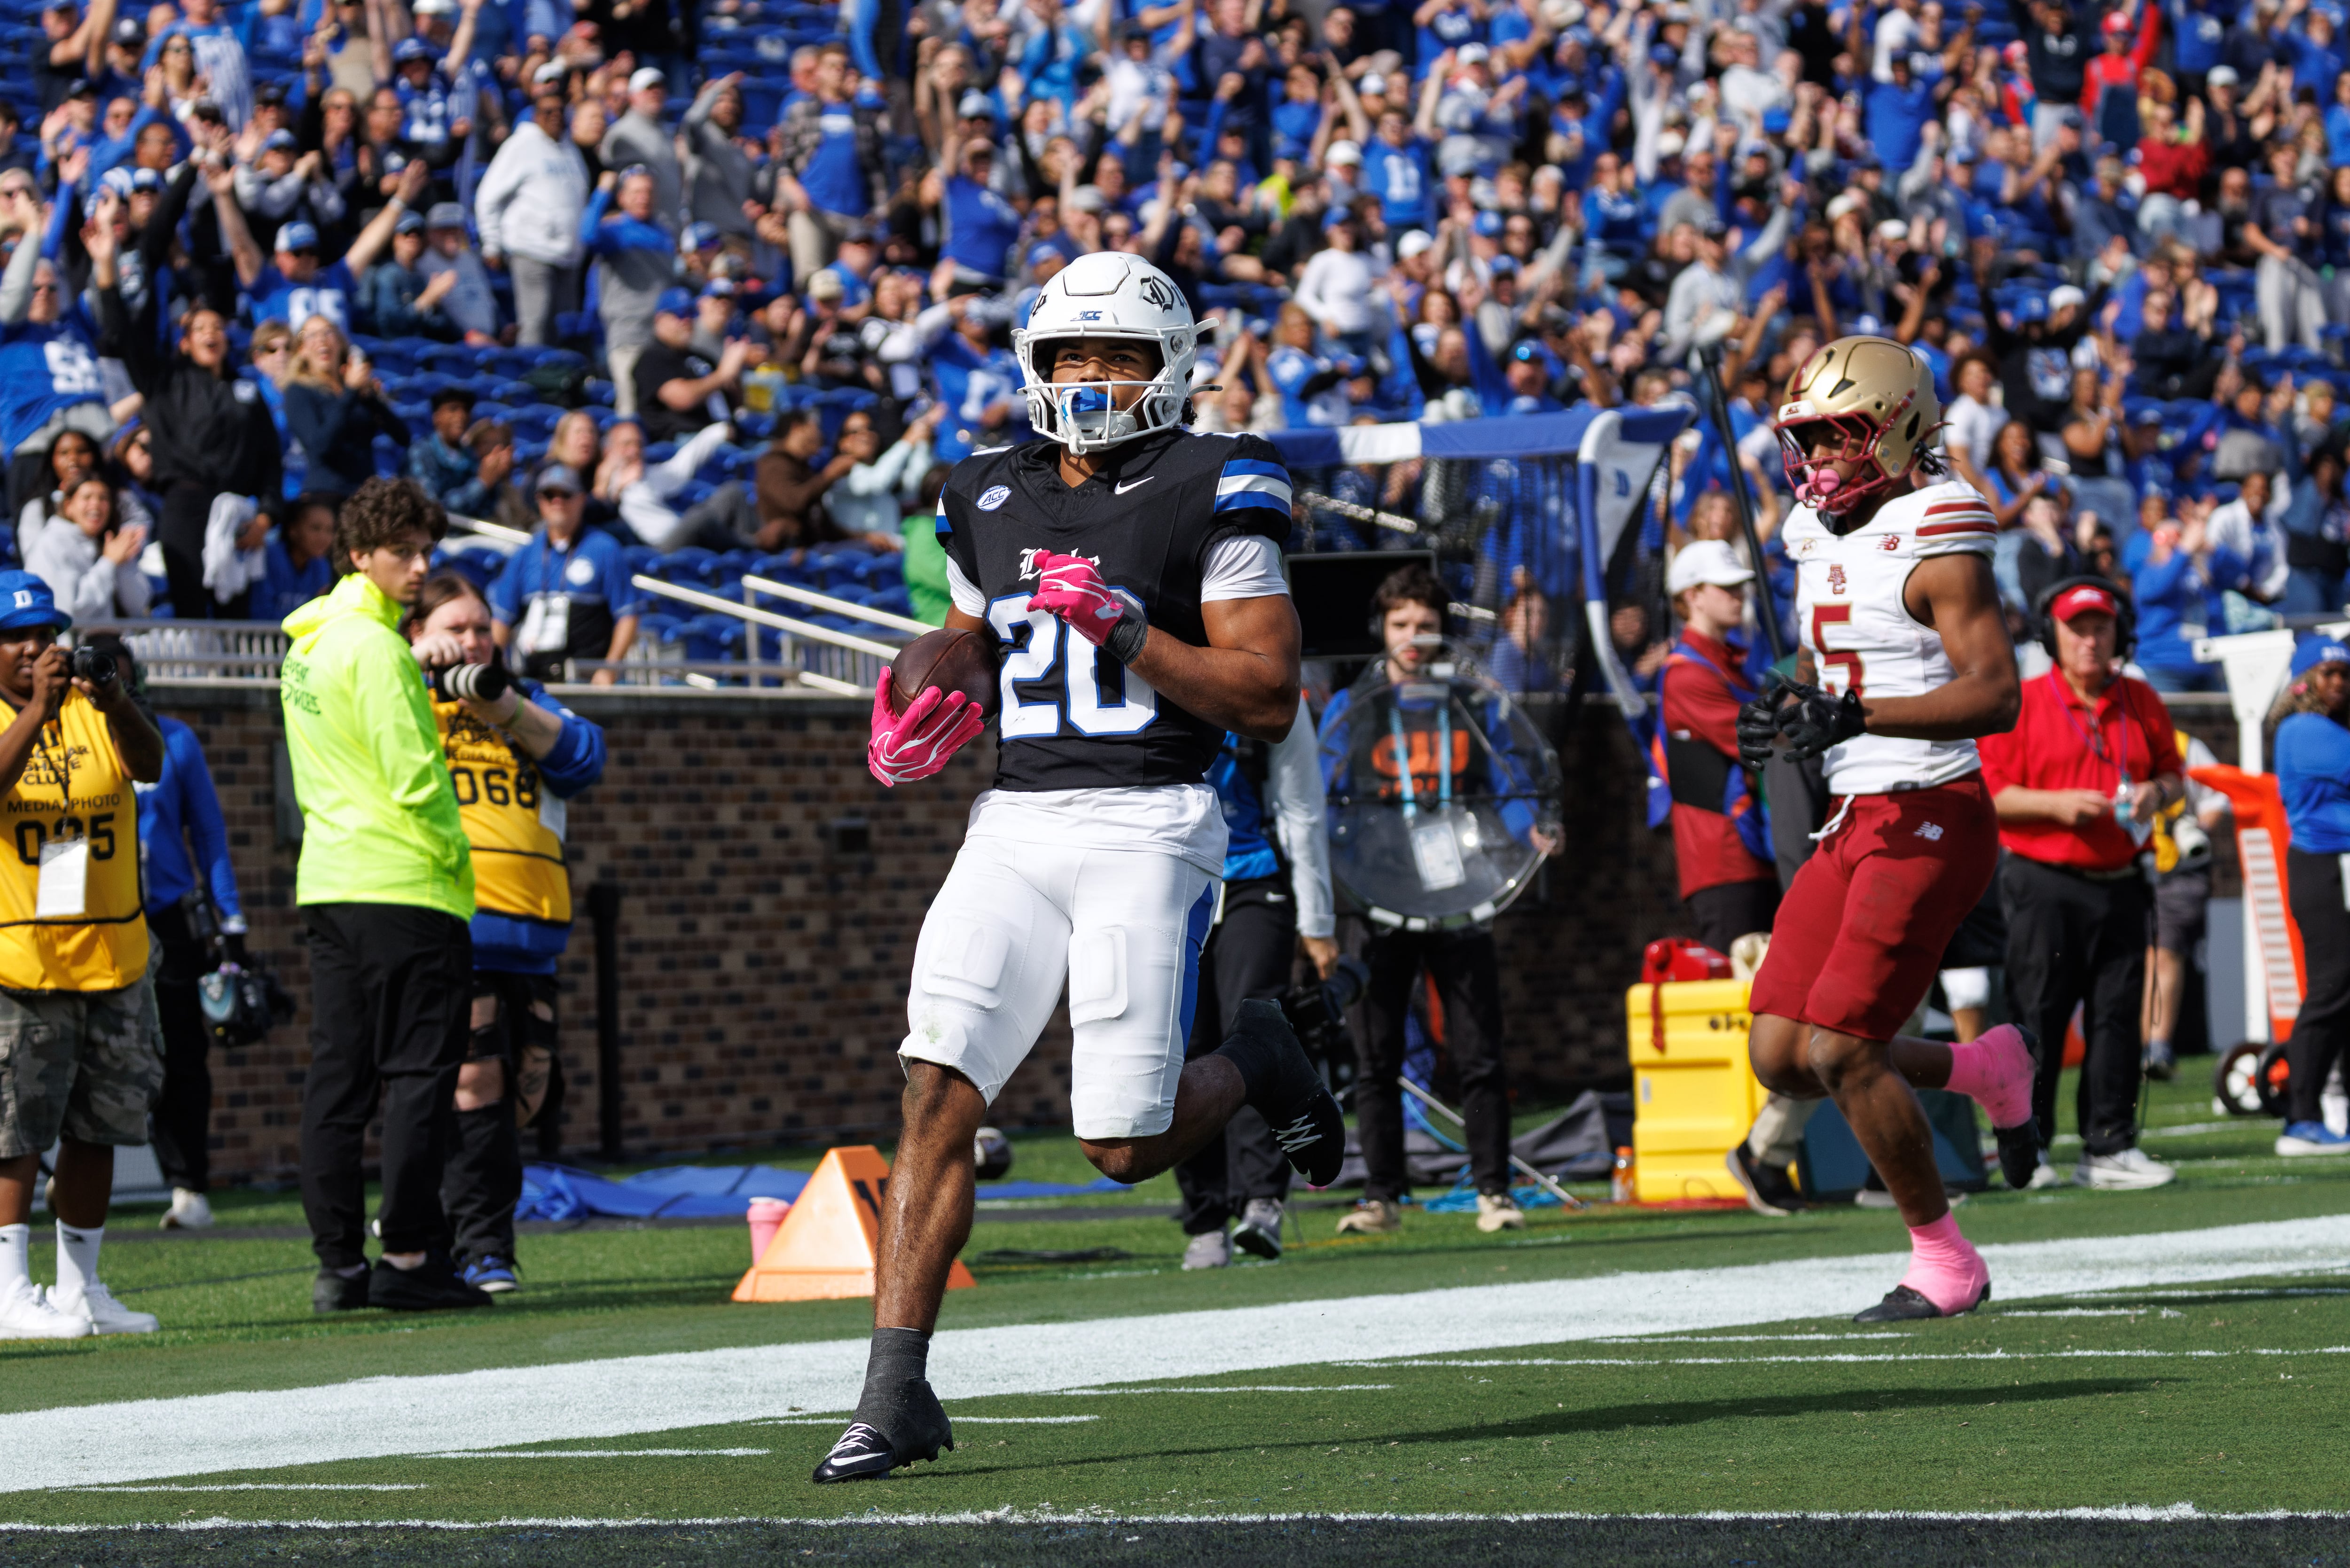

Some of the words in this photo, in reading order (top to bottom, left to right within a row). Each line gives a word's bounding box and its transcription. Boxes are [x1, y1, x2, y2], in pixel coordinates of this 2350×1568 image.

[982, 489, 1007, 504] ACC
[1812, 601, 1866, 699] 5
[987, 585, 1159, 743] 20
[24, 771, 71, 785] CLU
[7, 798, 61, 813] MEDIA
[70, 793, 121, 810] PHOTO
